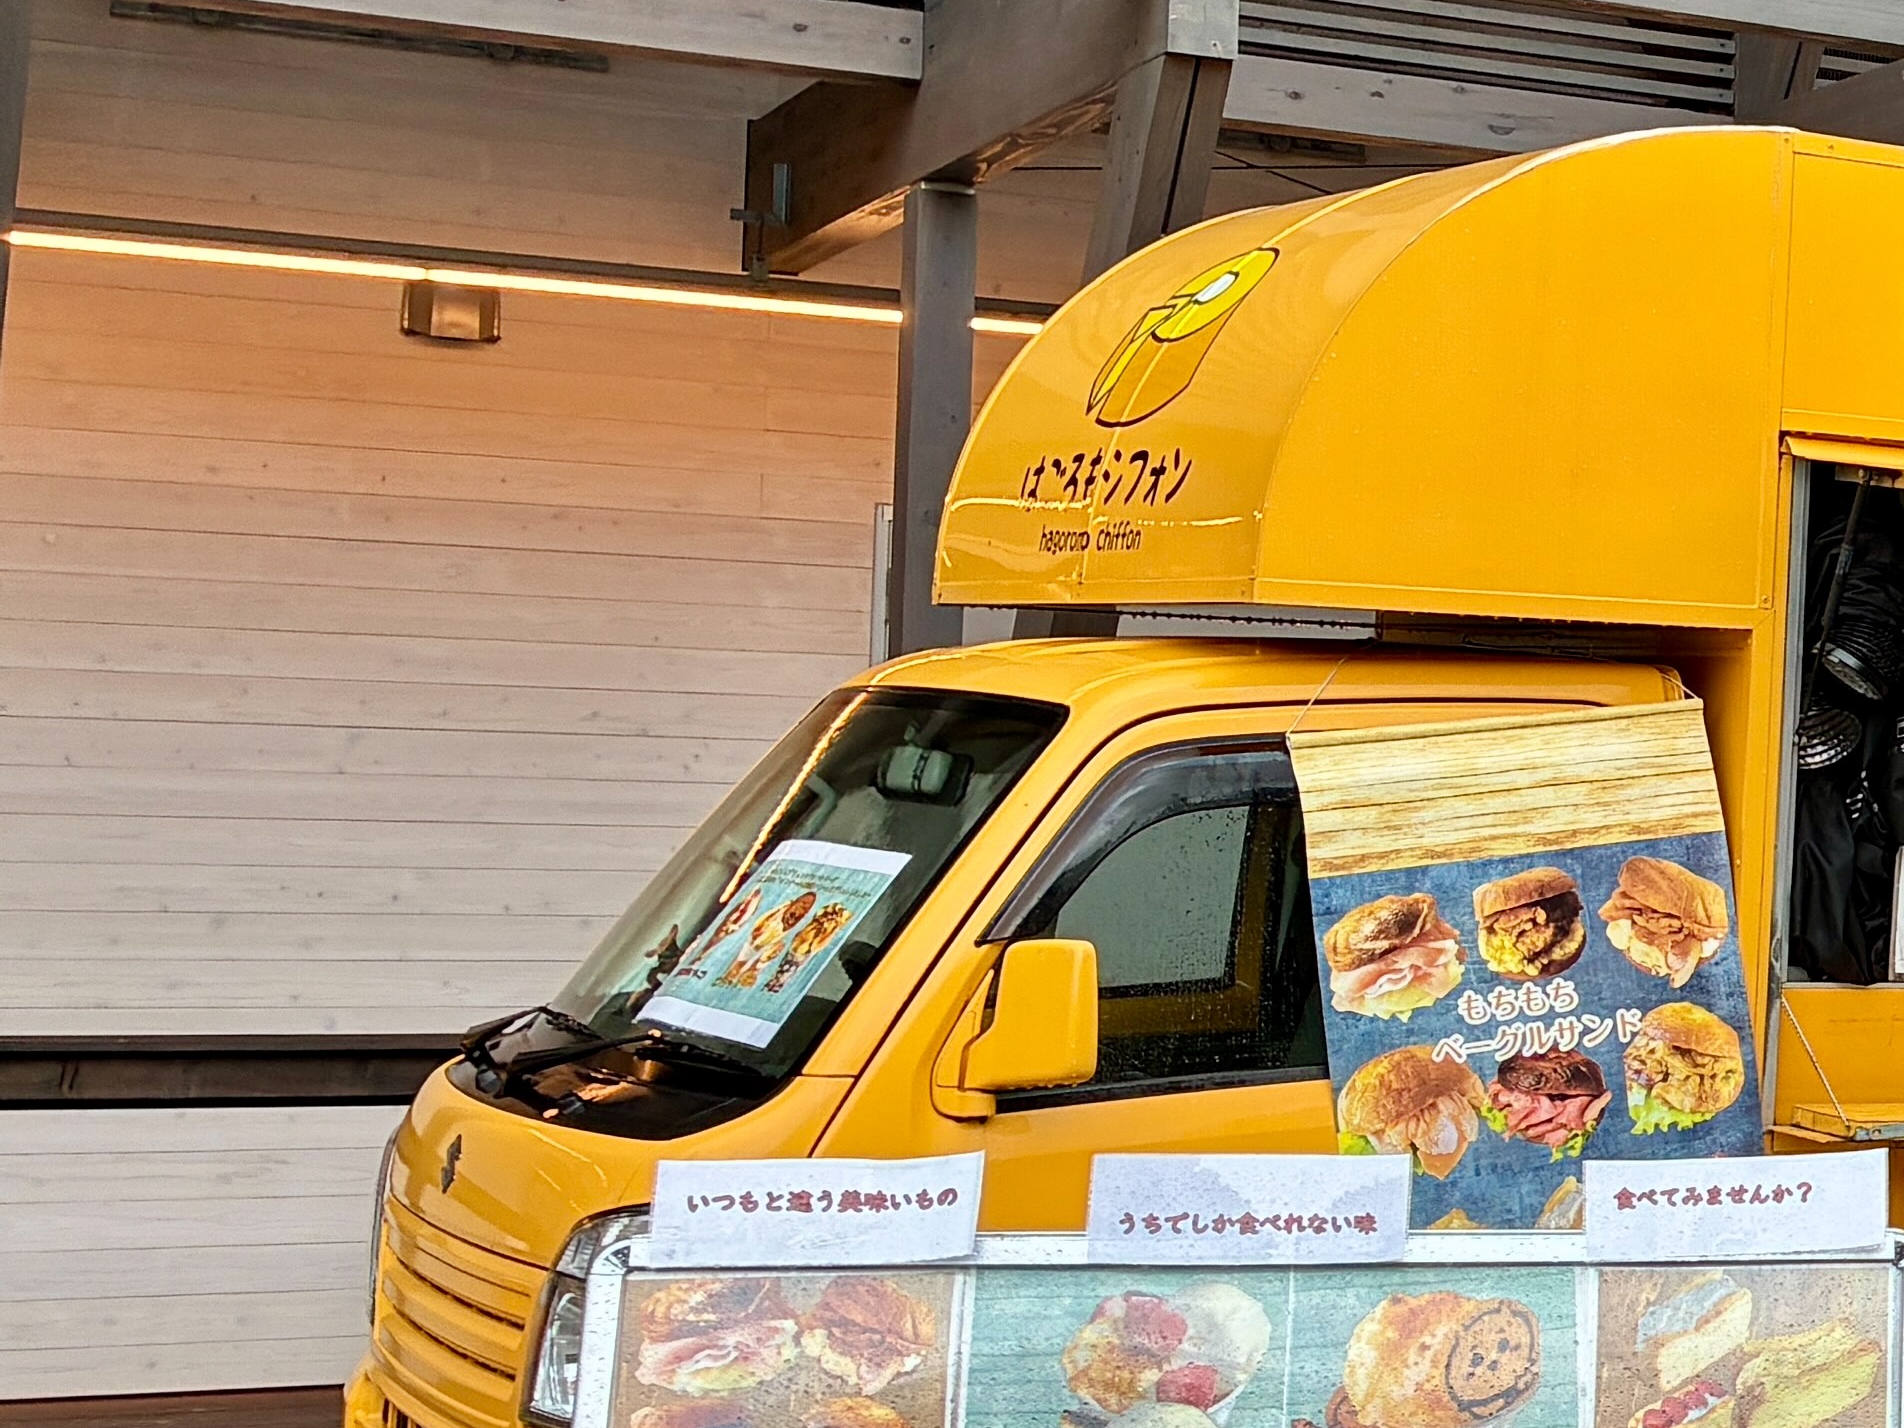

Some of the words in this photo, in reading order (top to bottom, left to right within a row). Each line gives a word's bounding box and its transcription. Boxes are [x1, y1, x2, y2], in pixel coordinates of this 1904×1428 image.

[1096, 520, 1142, 553] chiffon
[1457, 978, 1580, 1025] もちもち
[1431, 1009, 1645, 1063] ベーグルサンド
[685, 1186, 961, 1217] いつもと違う美味いもの
[1117, 1211, 1379, 1238] うちでしか食べれない味
